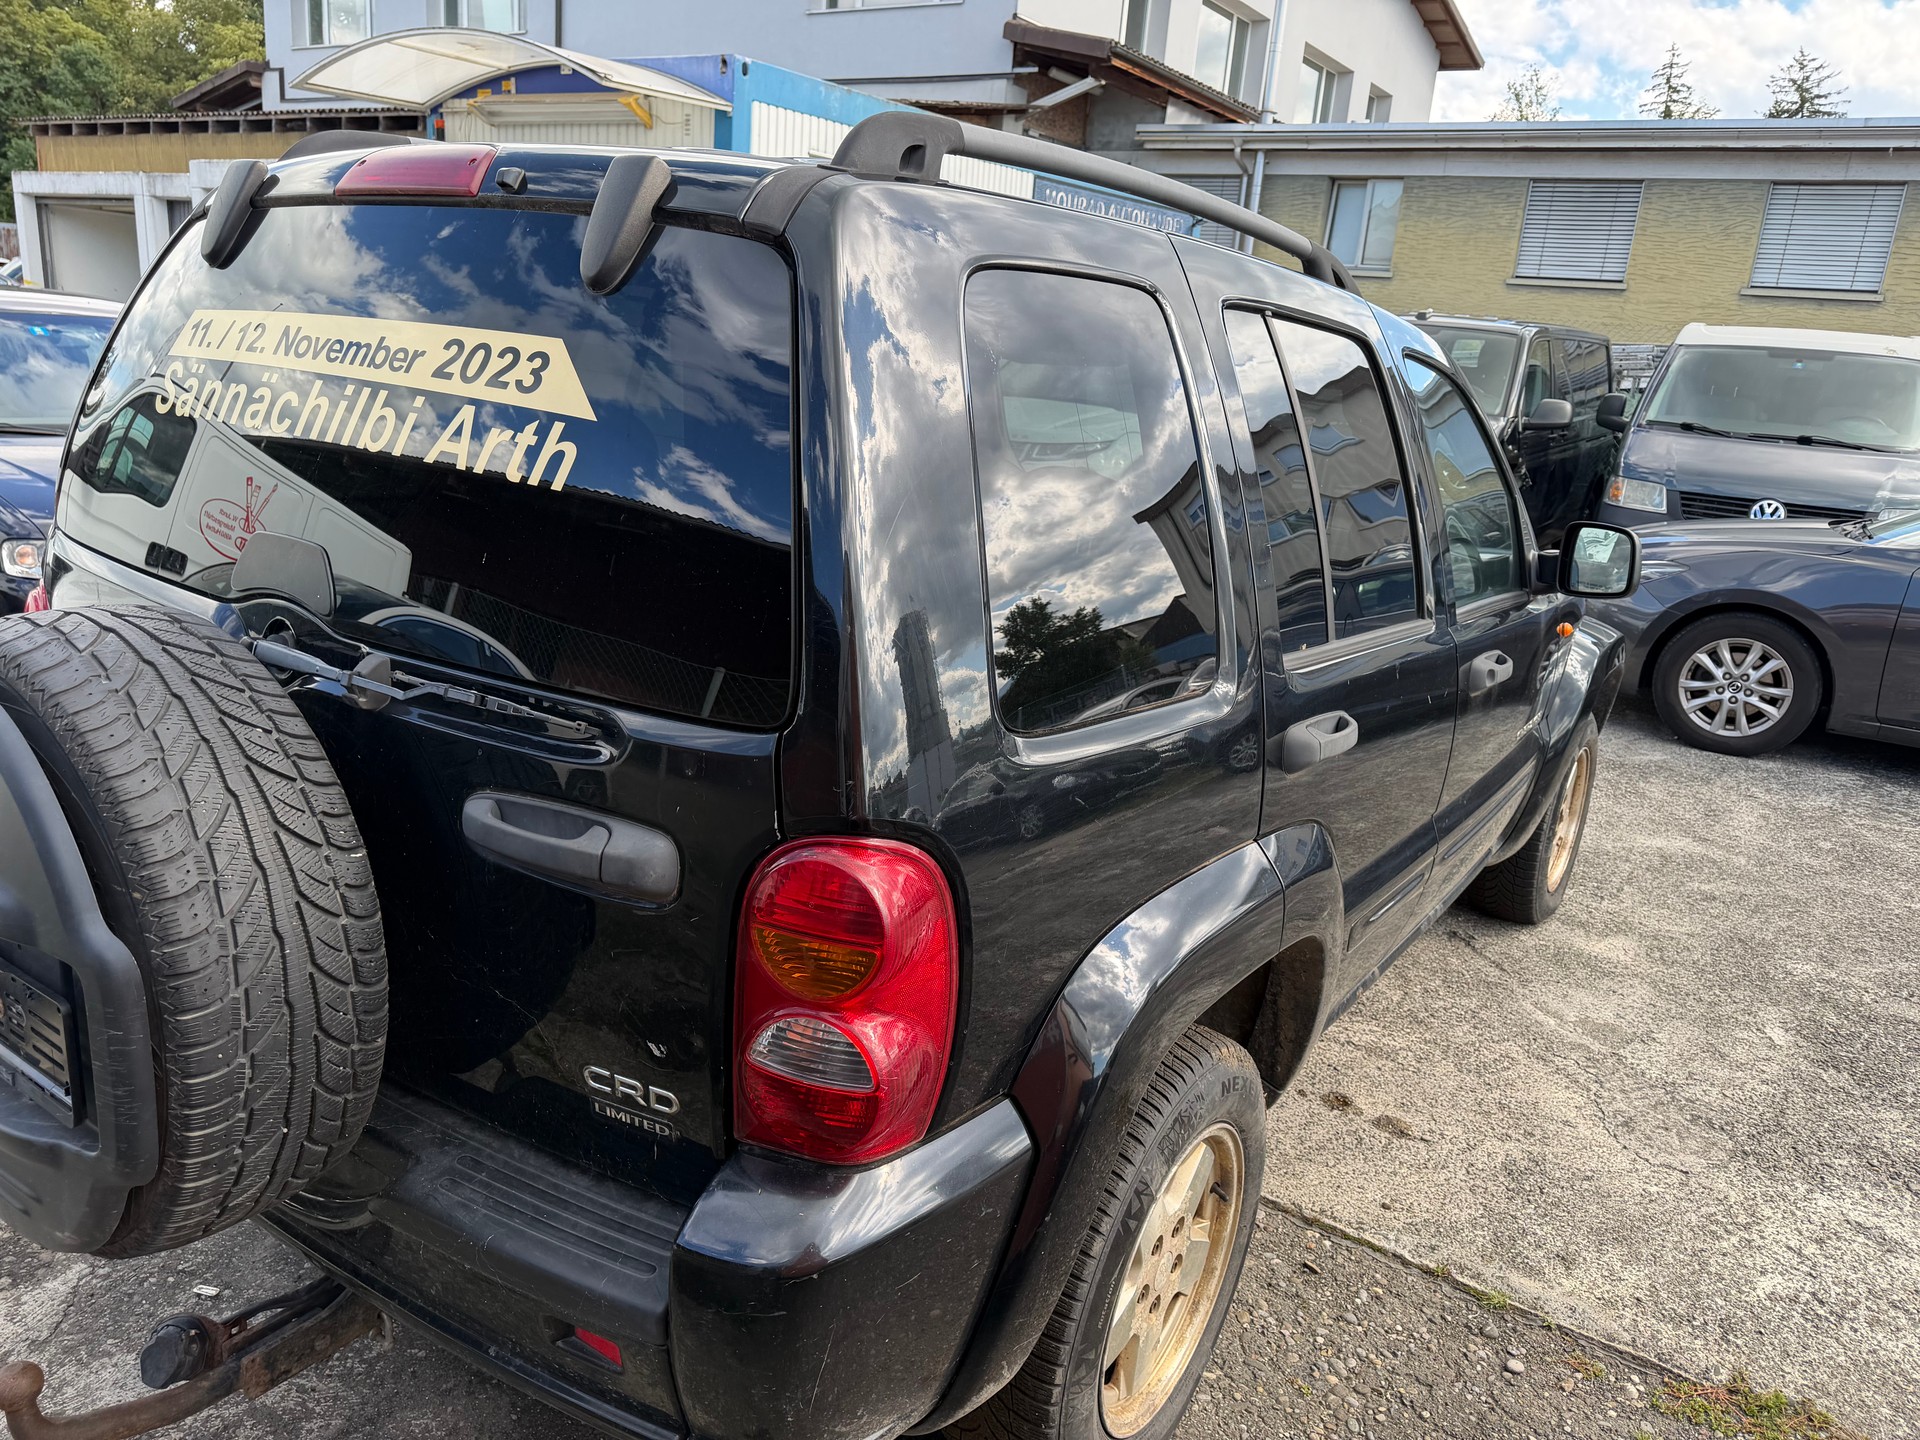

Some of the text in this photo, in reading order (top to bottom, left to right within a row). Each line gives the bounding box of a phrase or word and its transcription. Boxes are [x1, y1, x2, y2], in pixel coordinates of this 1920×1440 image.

[188, 318, 214, 348] 11.
[235, 321, 267, 354] 12.
[273, 324, 427, 374] November
[430, 338, 551, 395] 2023
[155, 361, 578, 492] Sännächilbi Arth
[583, 1065, 680, 1136] CRD LIMITED
